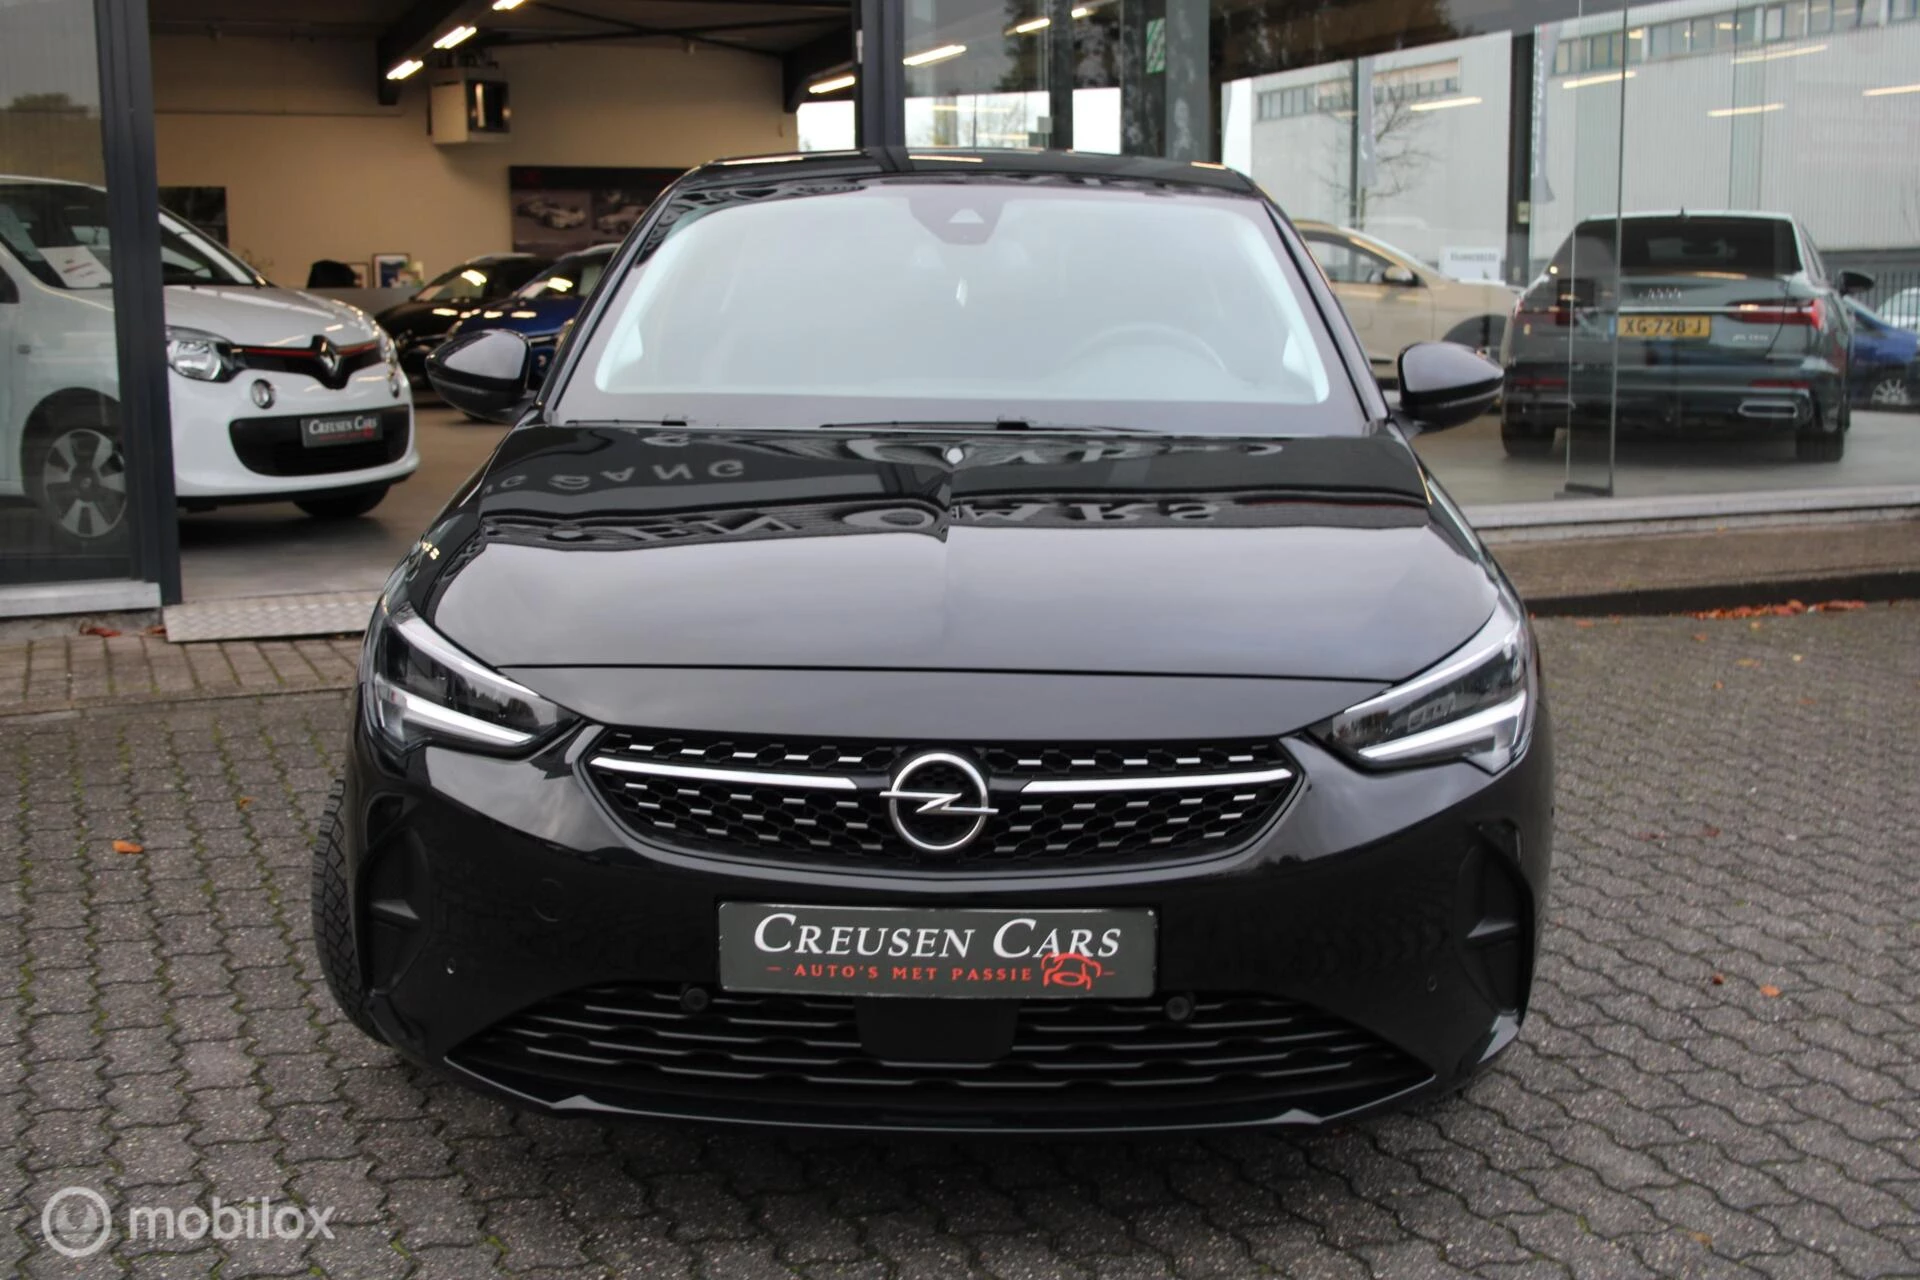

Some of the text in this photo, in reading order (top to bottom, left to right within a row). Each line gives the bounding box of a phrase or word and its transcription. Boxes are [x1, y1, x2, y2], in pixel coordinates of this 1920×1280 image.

[753, 912, 1121, 958] CREUSEN CARS
[794, 963, 1032, 982] AUTO'S MET PASSIE
